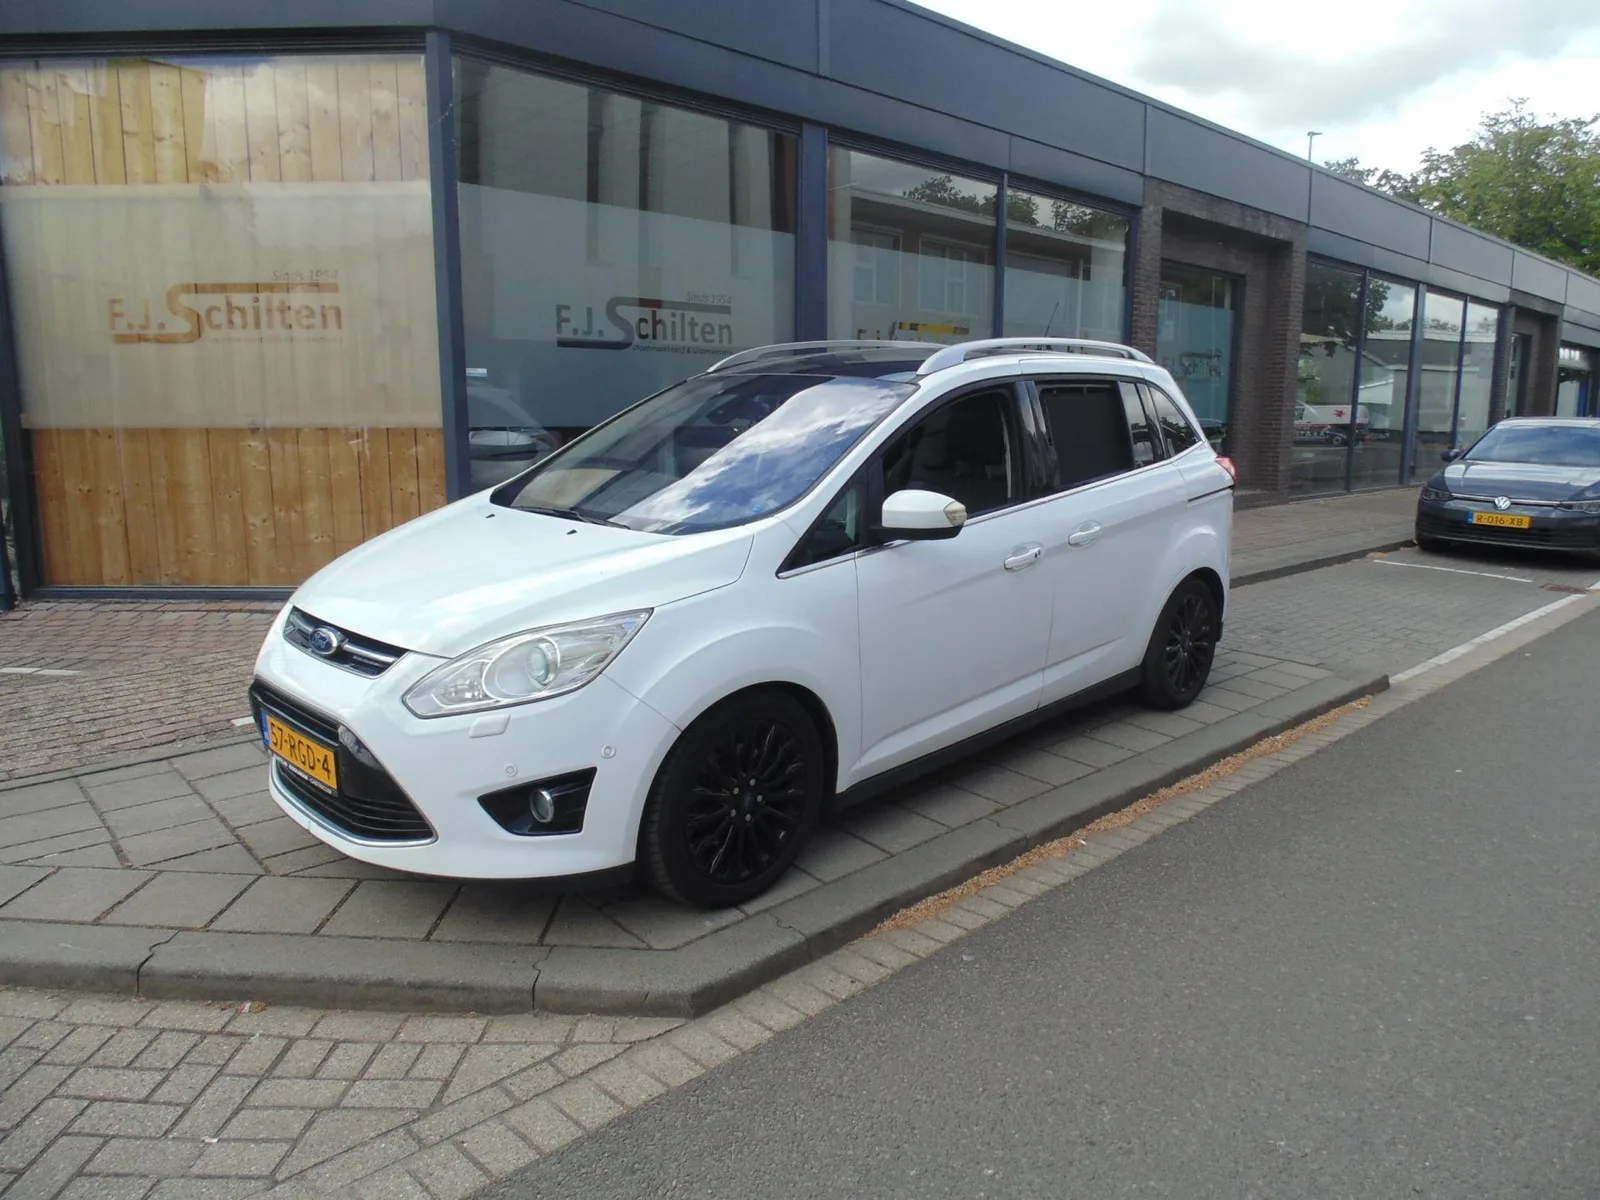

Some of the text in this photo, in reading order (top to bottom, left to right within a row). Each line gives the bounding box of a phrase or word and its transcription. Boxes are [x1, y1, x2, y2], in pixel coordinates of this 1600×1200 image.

[106, 282, 343, 344] F.J. Schilten
[555, 295, 733, 350] F.J. Schilten
[1476, 514, 1524, 526] R-016-XB
[270, 720, 331, 780] 57-RGD-4
